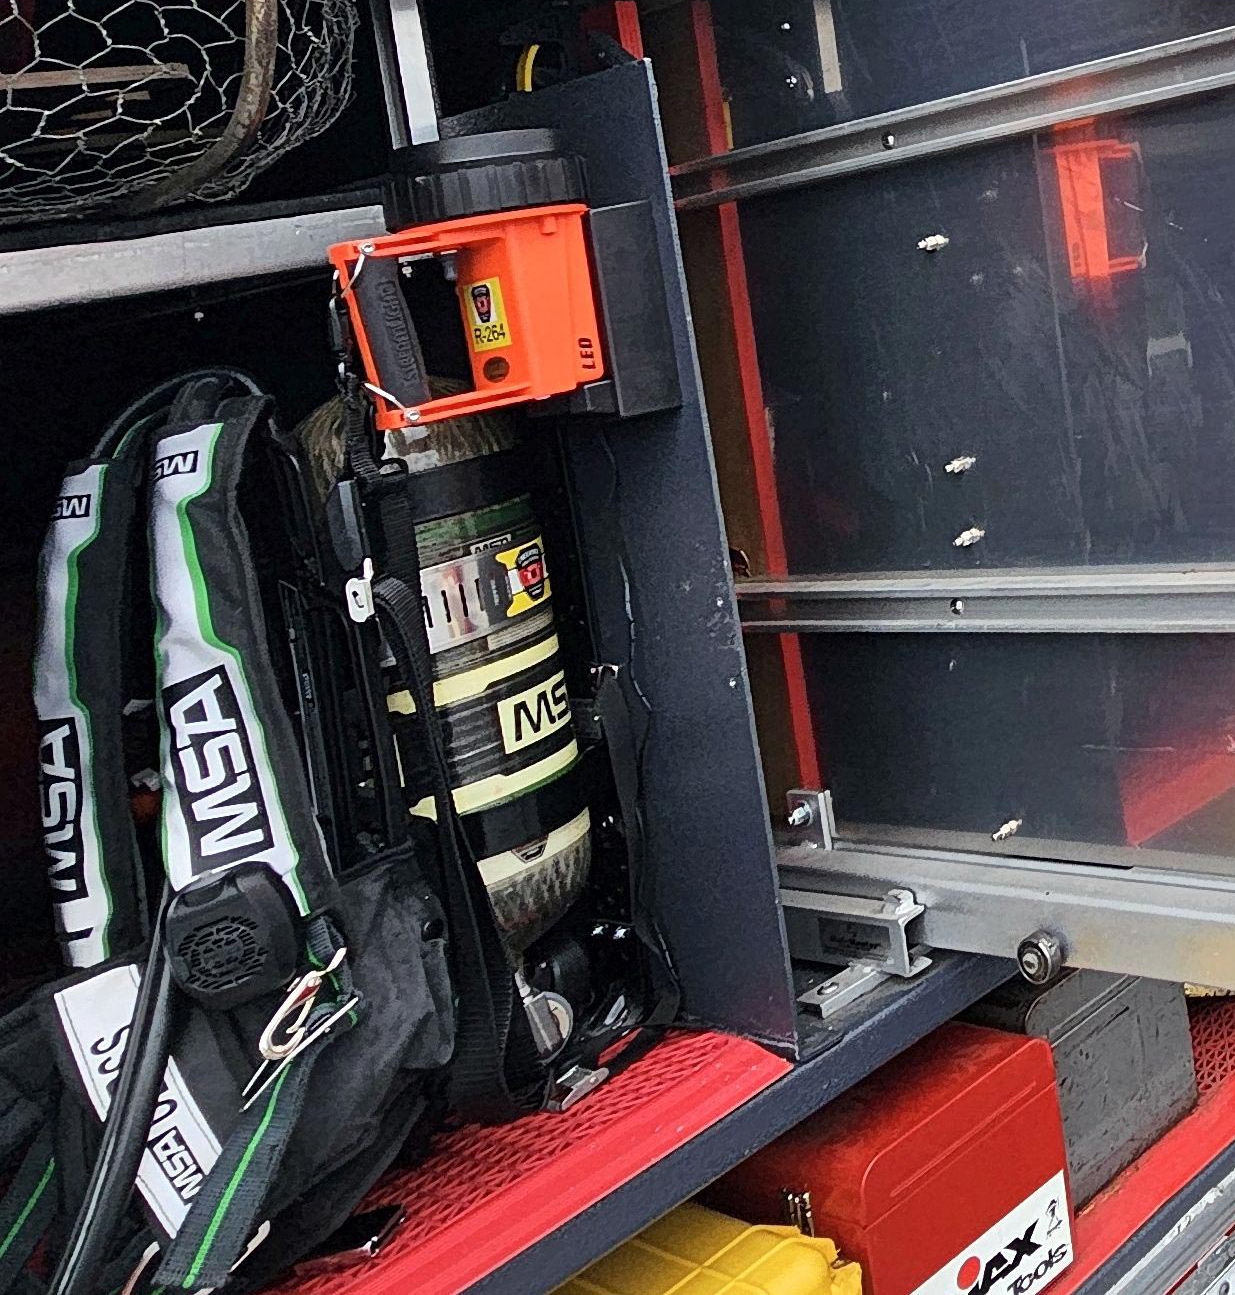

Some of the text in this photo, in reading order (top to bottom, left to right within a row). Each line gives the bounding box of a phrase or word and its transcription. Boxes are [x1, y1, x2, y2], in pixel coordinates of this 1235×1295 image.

[474, 323, 506, 345] R-264
[577, 337, 596, 370] LED
[513, 679, 569, 742] MS
[170, 673, 264, 858] MSA
[42, 724, 77, 891] MSA
[153, 1129, 203, 1199] MSA
